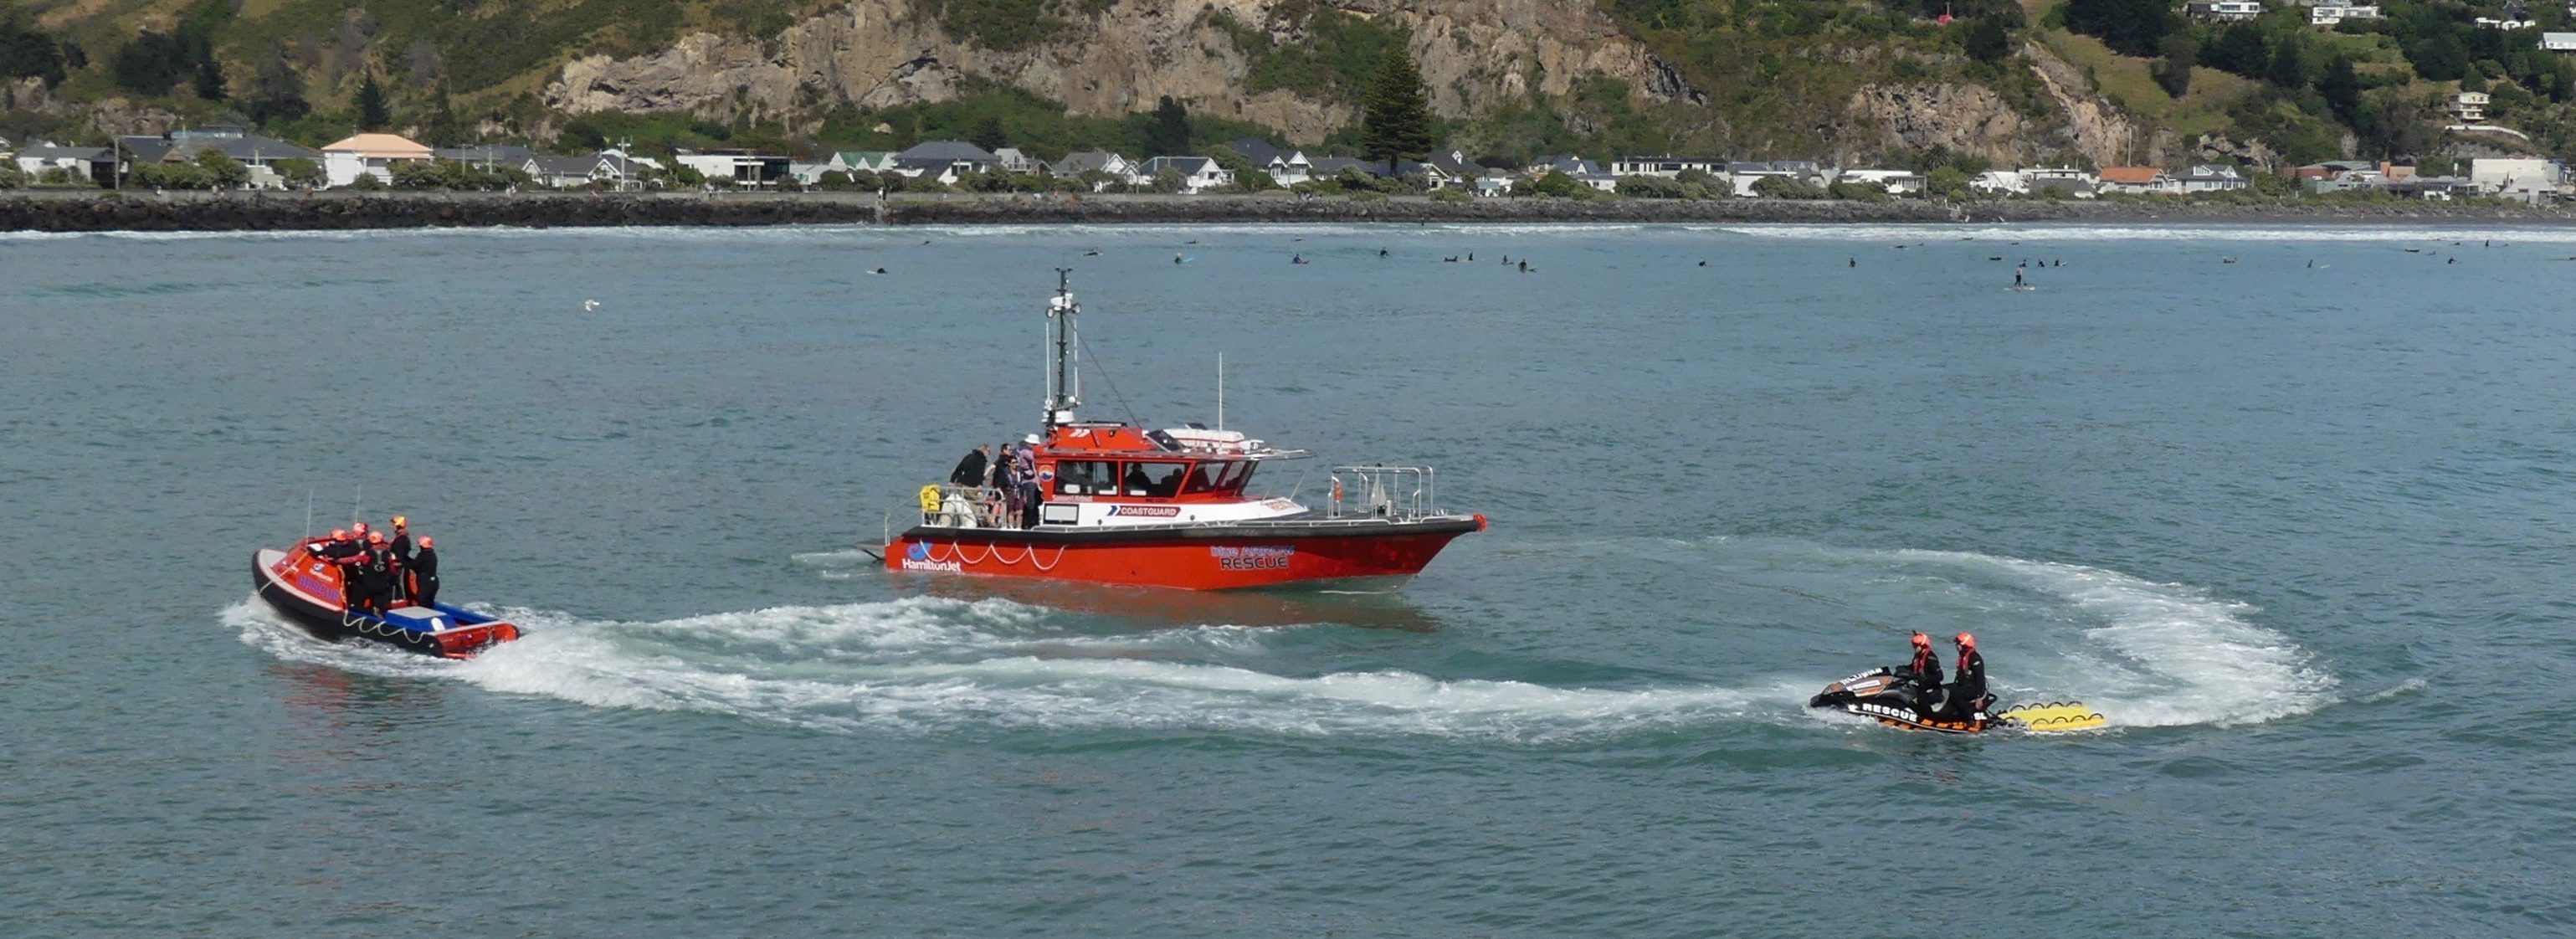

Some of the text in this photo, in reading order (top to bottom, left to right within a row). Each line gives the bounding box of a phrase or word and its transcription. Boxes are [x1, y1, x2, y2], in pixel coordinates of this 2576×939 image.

[1121, 506, 1177, 516] COASTGUARD
[901, 558, 962, 572] HamiltonJet
[1219, 557, 1289, 570] RESCUE
[1862, 703, 1918, 722] RESCUE
